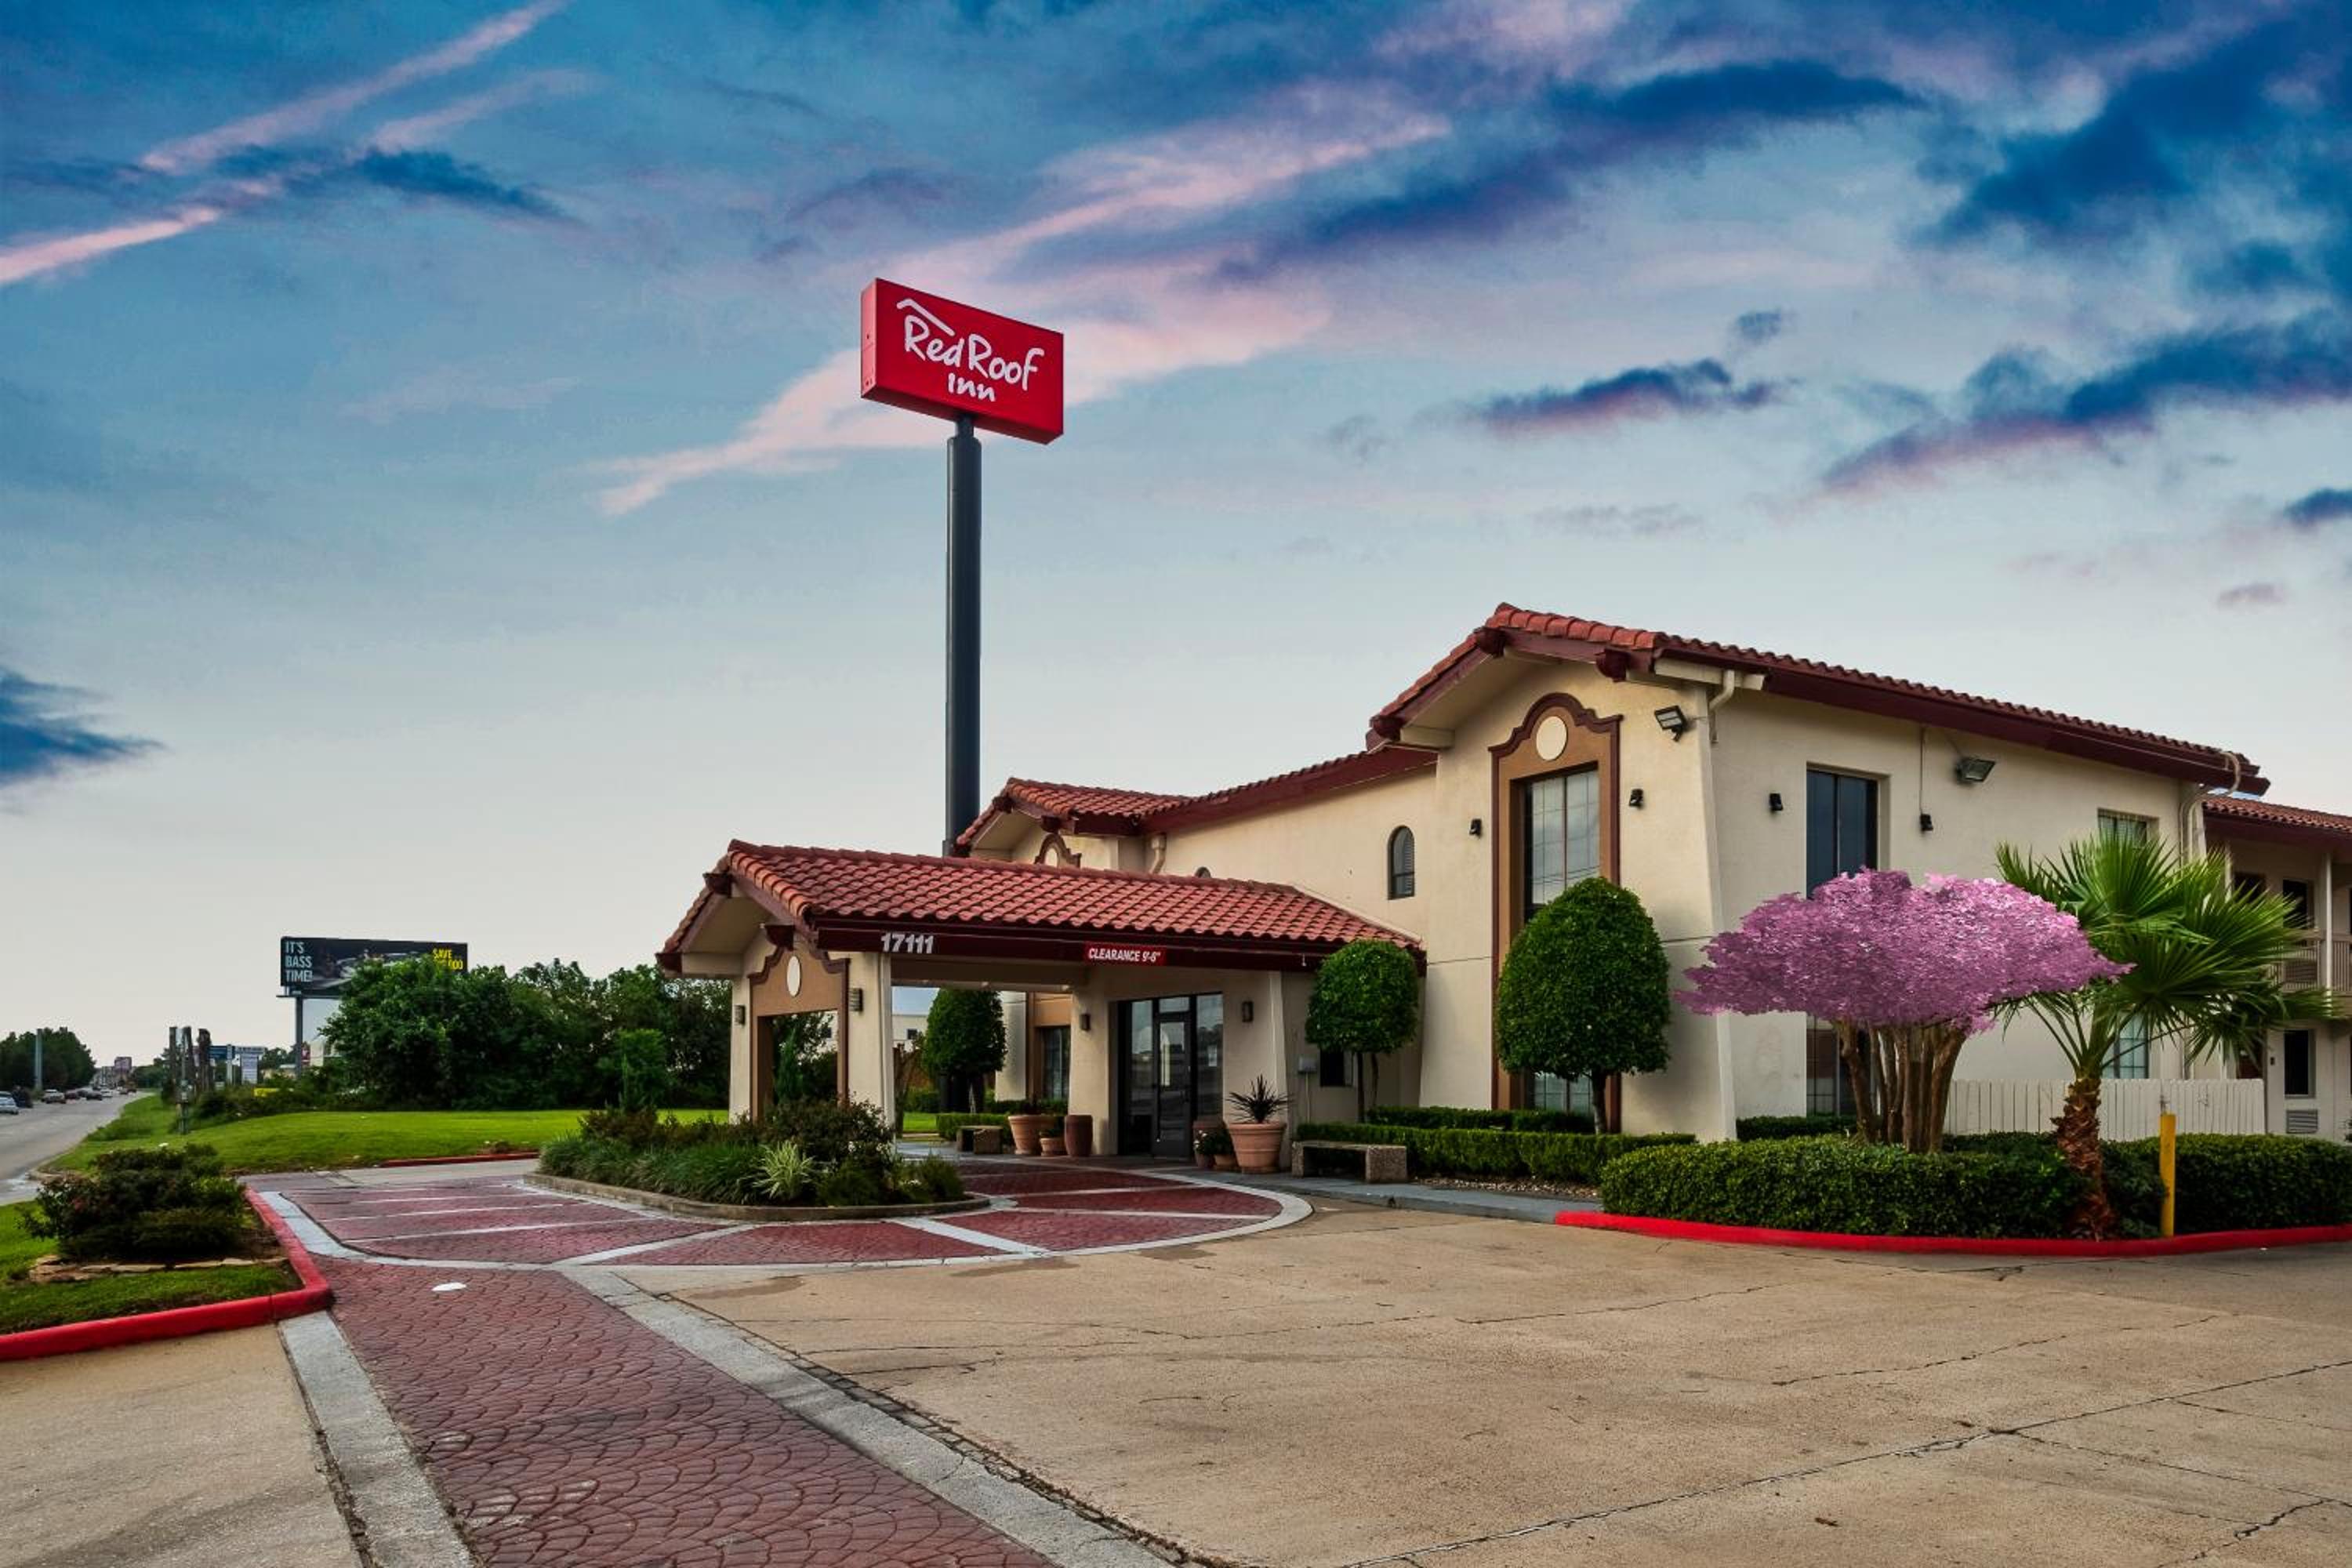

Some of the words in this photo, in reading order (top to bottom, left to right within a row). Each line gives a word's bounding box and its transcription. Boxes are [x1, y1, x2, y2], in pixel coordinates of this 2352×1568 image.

[904, 315, 964, 368] Red
[968, 333, 1044, 391] Roof
[948, 372, 995, 402] Inn
[285, 941, 304, 953] IT'S
[880, 932, 934, 954] 17111
[285, 955, 312, 968] BASS
[1088, 948, 1140, 962] CLEARANCE
